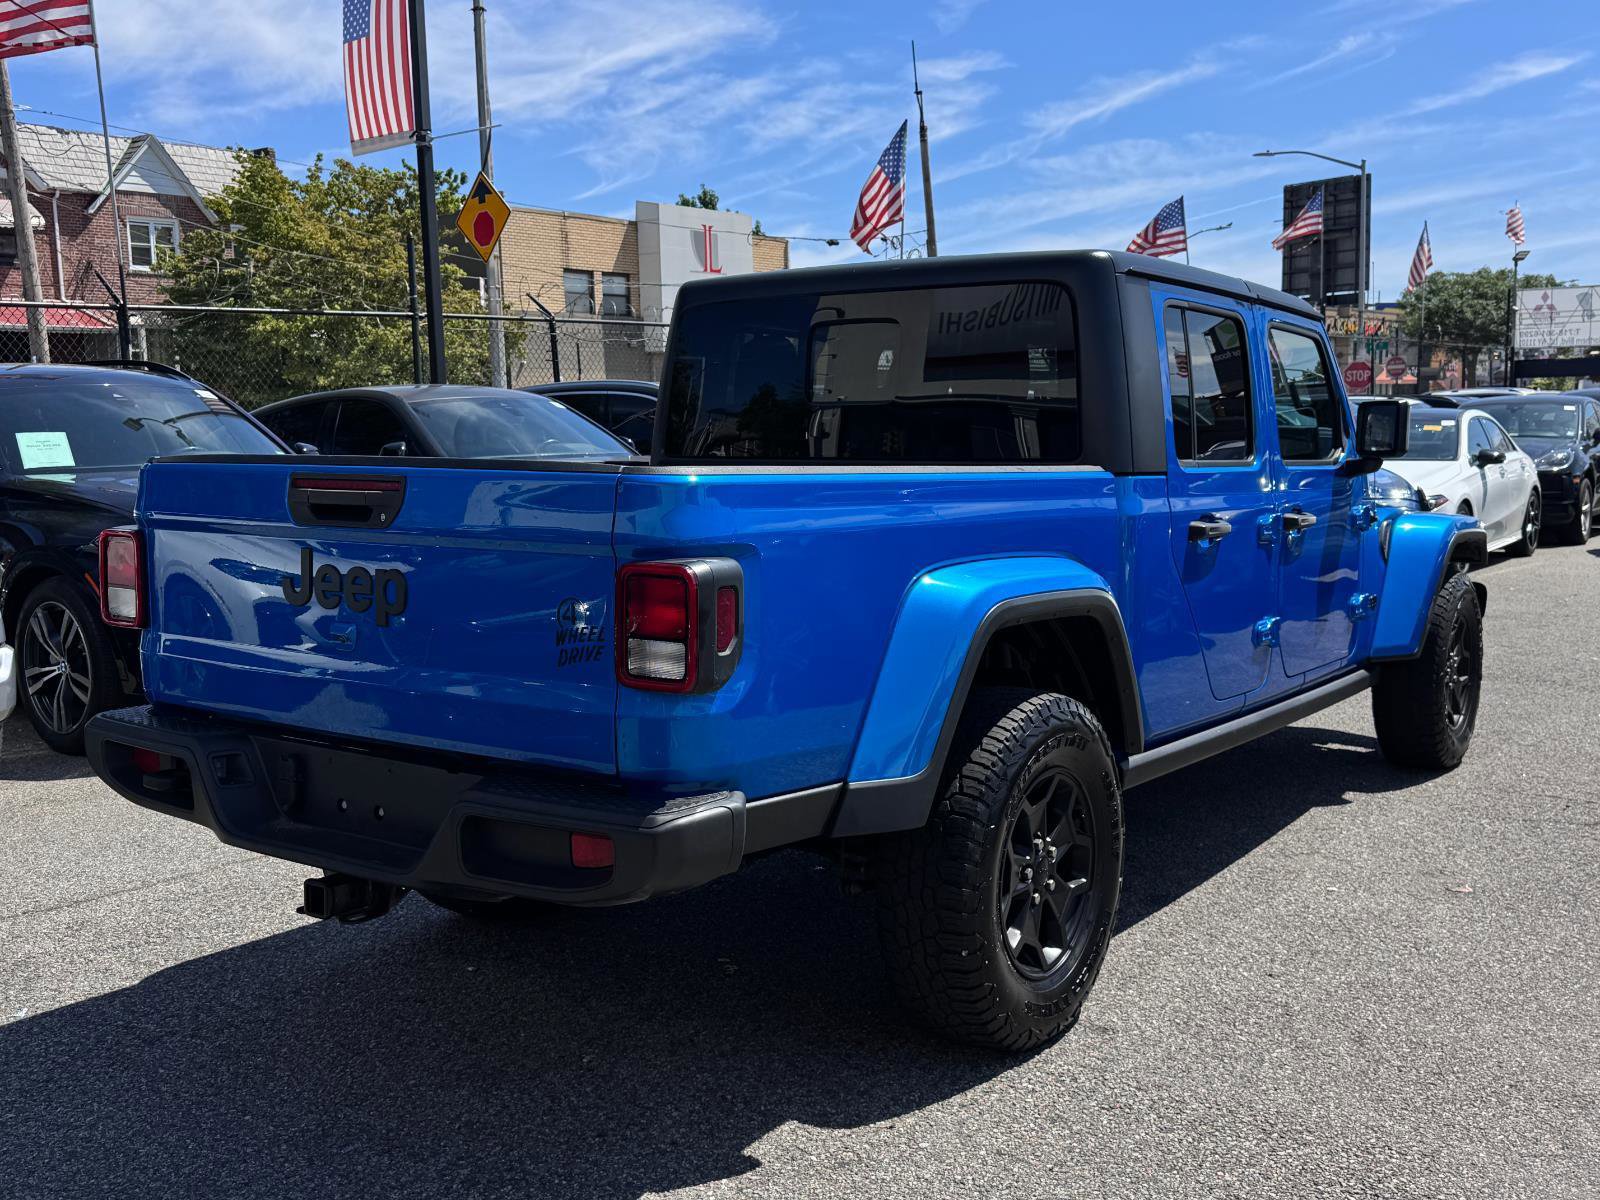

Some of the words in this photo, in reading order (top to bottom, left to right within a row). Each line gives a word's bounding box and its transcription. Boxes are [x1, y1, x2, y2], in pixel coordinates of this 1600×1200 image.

[1345, 370, 1371, 382] STOP
[282, 546, 408, 628] Jeep
[555, 625, 605, 647] WHEEL
[557, 645, 605, 668] DRIVE
